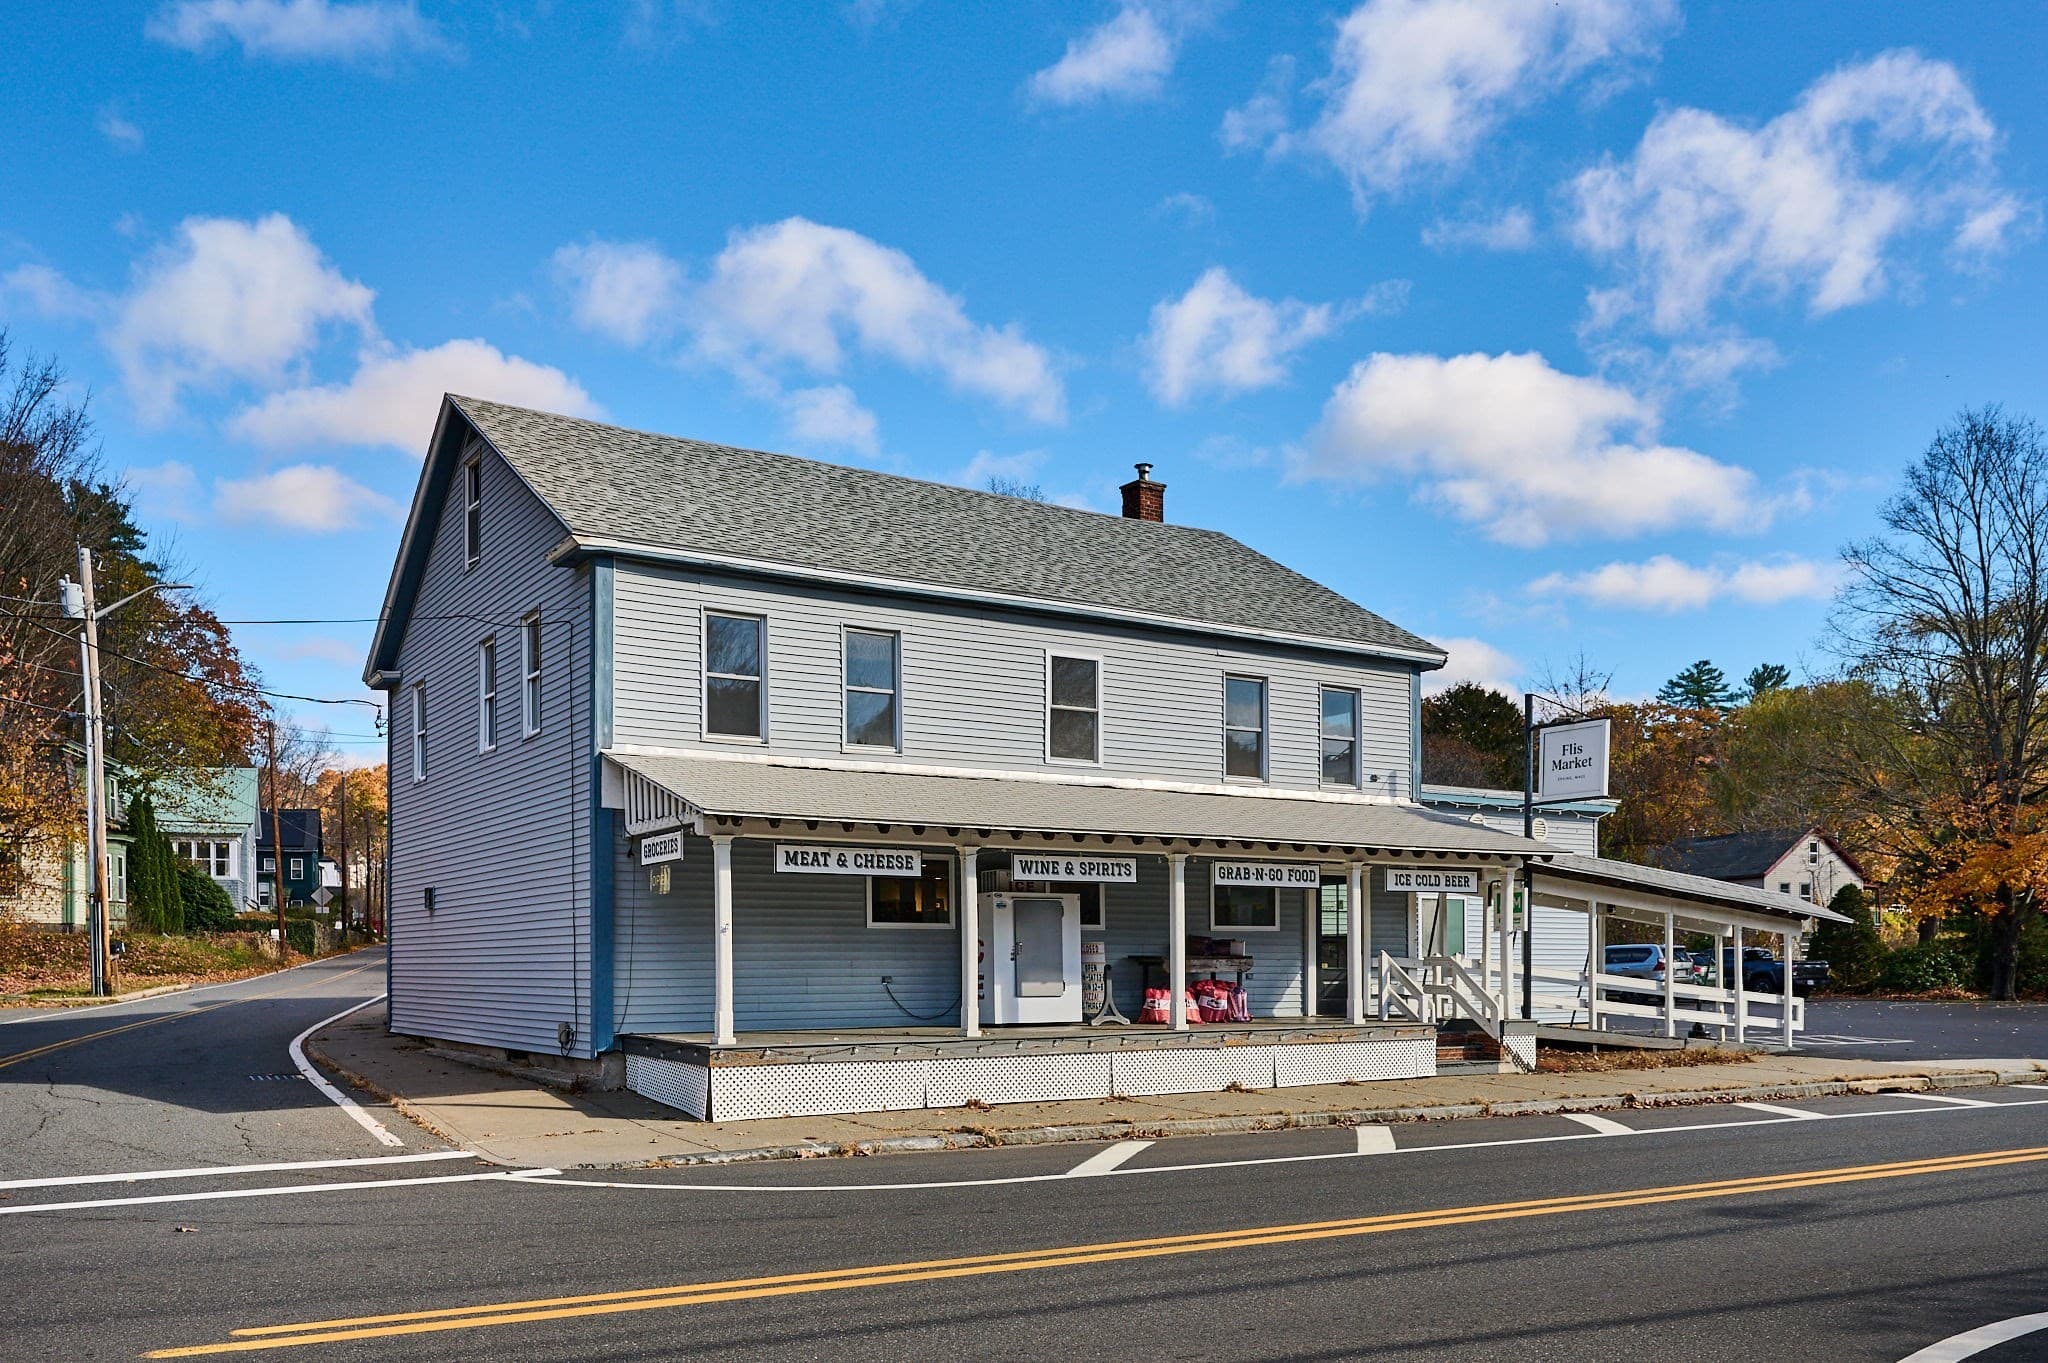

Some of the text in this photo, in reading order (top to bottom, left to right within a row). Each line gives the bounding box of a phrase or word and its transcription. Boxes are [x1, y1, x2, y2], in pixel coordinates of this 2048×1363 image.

[1562, 743, 1583, 756] Flis
[1552, 757, 1592, 771] Market
[643, 837, 679, 858] GROCERIES
[784, 850, 914, 870] MEAT & CHEESE
[1019, 860, 1133, 877] WINE & SPIRITS
[1288, 868, 1317, 882] FOOD
[1009, 881, 1034, 892] ICE
[1394, 874, 1470, 888] ICE COLD BEER
